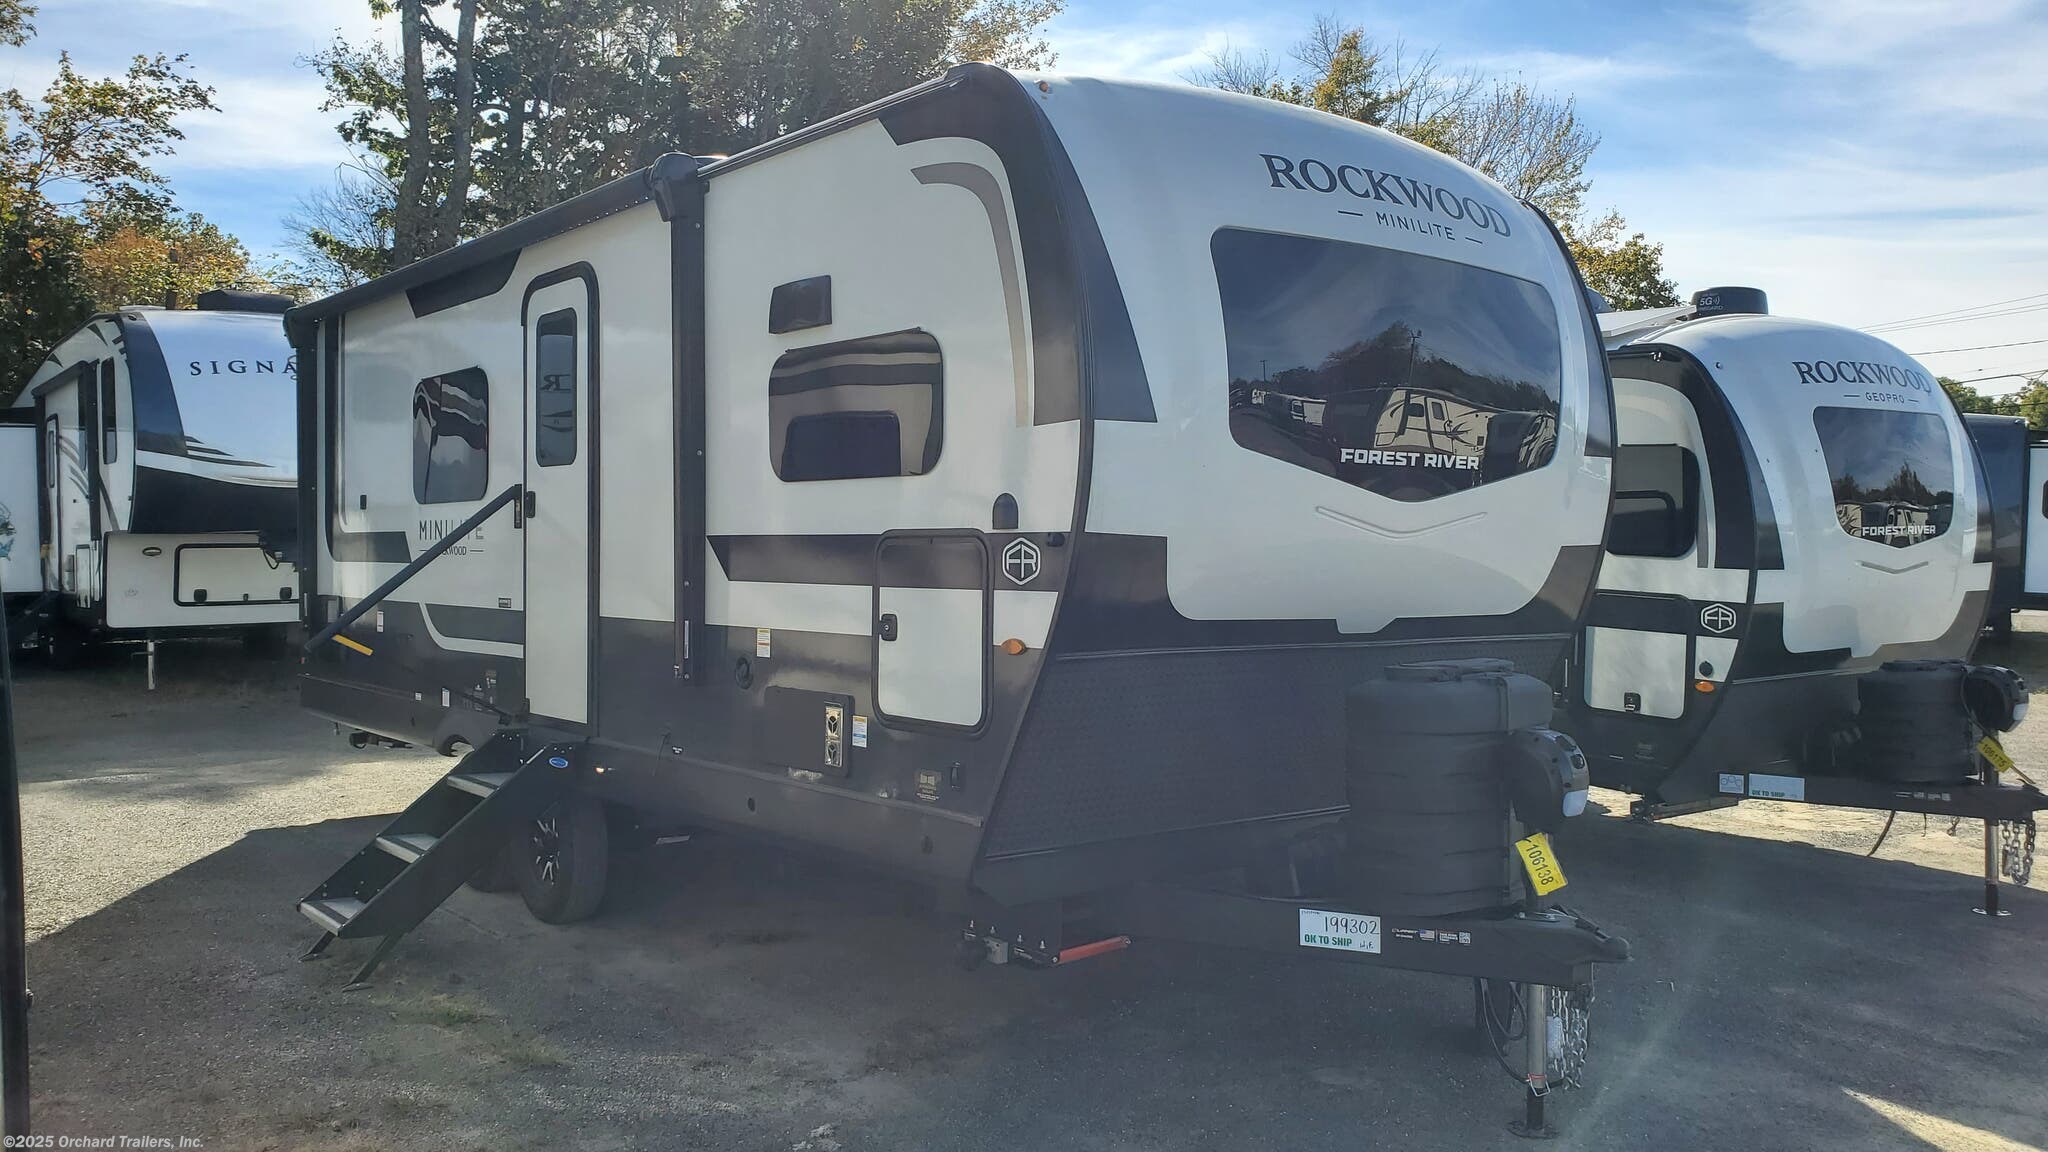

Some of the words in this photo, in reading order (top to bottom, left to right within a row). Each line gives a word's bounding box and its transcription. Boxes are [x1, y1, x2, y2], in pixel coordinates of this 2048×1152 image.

[1260, 153, 1512, 238] ROCKWOOD
[1375, 211, 1456, 242] MINILITE
[1699, 296, 1713, 306] 5G
[1792, 360, 1933, 394] ROCKWOOD
[1865, 391, 1905, 404] GEOPRO
[1340, 448, 1421, 467] FOREST
[1423, 453, 1480, 470] RIVER
[1862, 525, 1906, 536] FOREST
[1907, 525, 1936, 535] RIVER
[1526, 844, 1554, 886] 106138
[1325, 916, 1381, 935] 199302
[1304, 933, 1317, 944] OK
[1318, 935, 1330, 945] TO
[1331, 936, 1353, 947] SHIP
